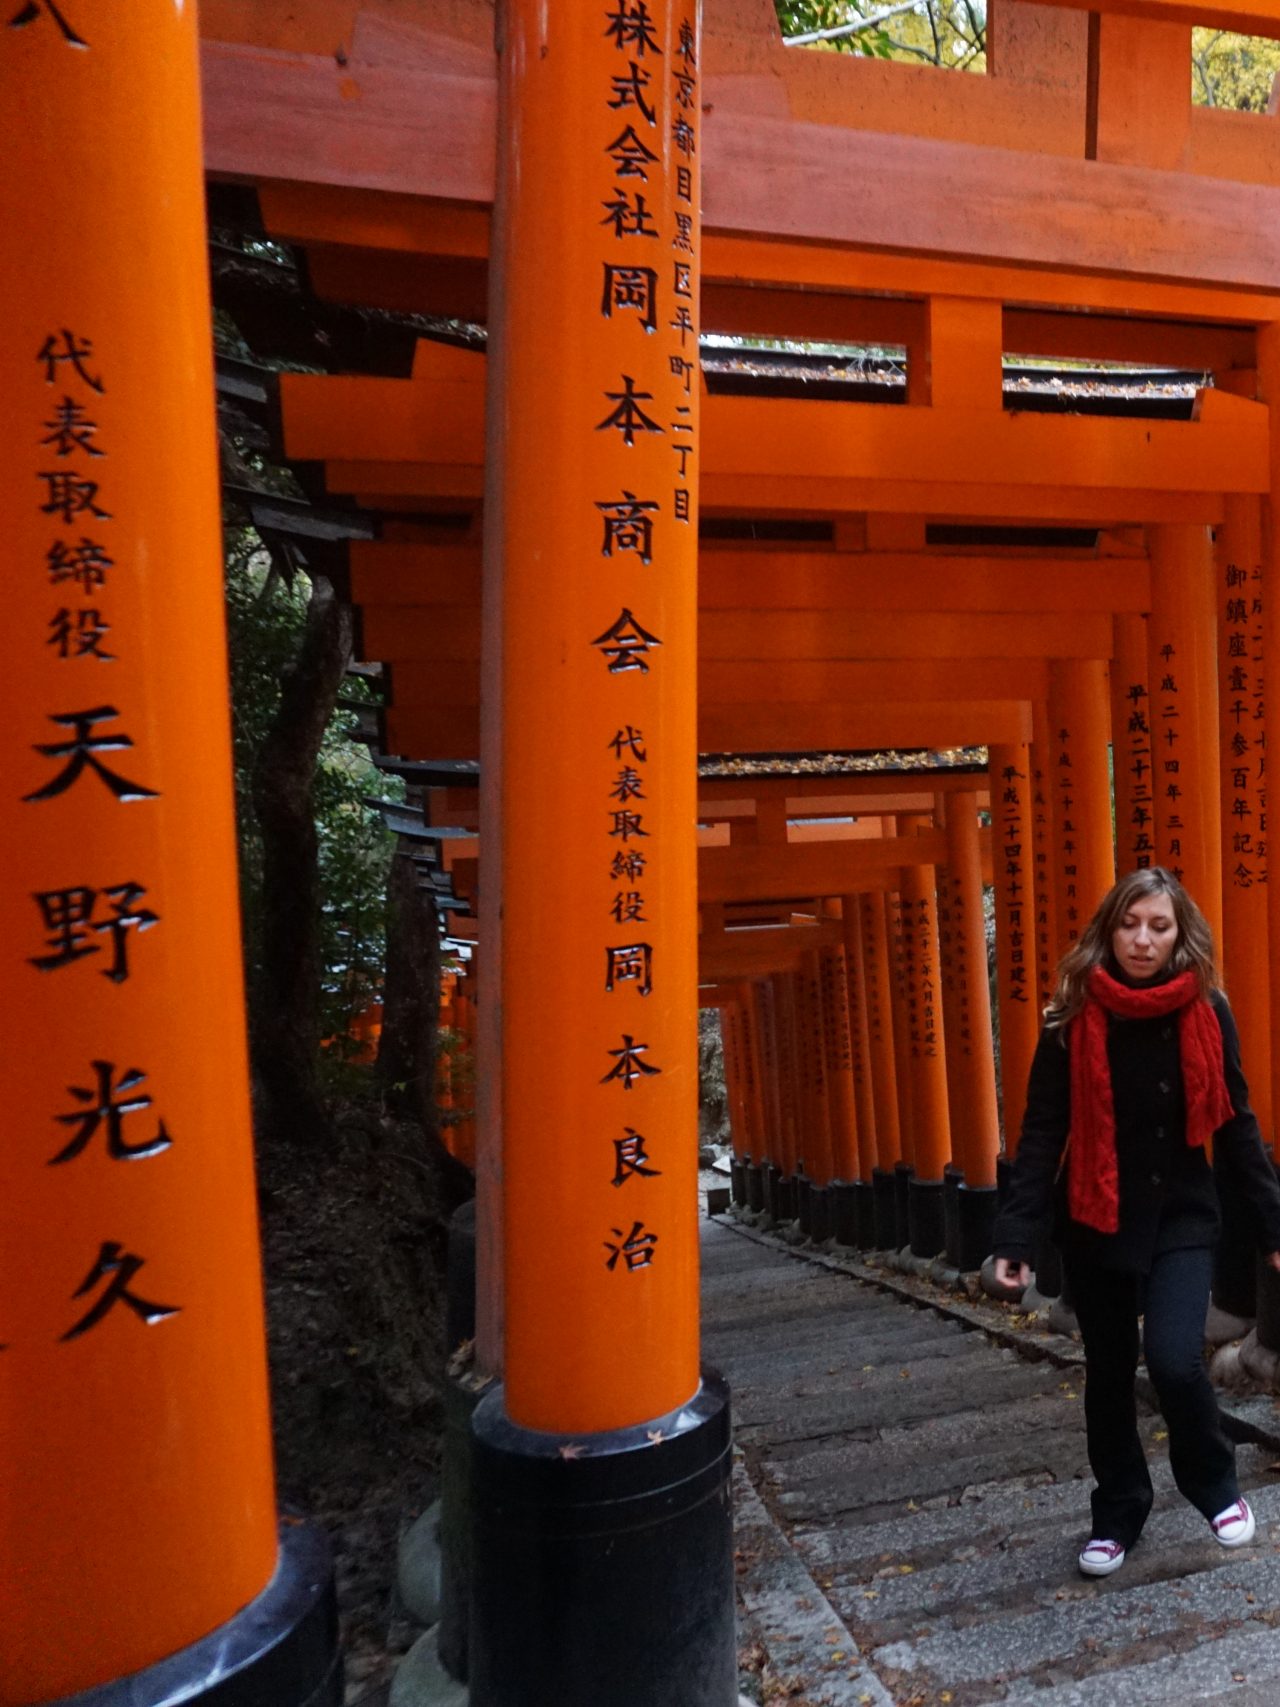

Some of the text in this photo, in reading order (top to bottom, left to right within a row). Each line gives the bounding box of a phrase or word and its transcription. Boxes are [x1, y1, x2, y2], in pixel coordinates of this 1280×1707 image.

[669, 18, 697, 524] 東京都目黒区平町二丁目
[1001, 765, 1029, 1003] 平成二十四年十一月吉日建之
